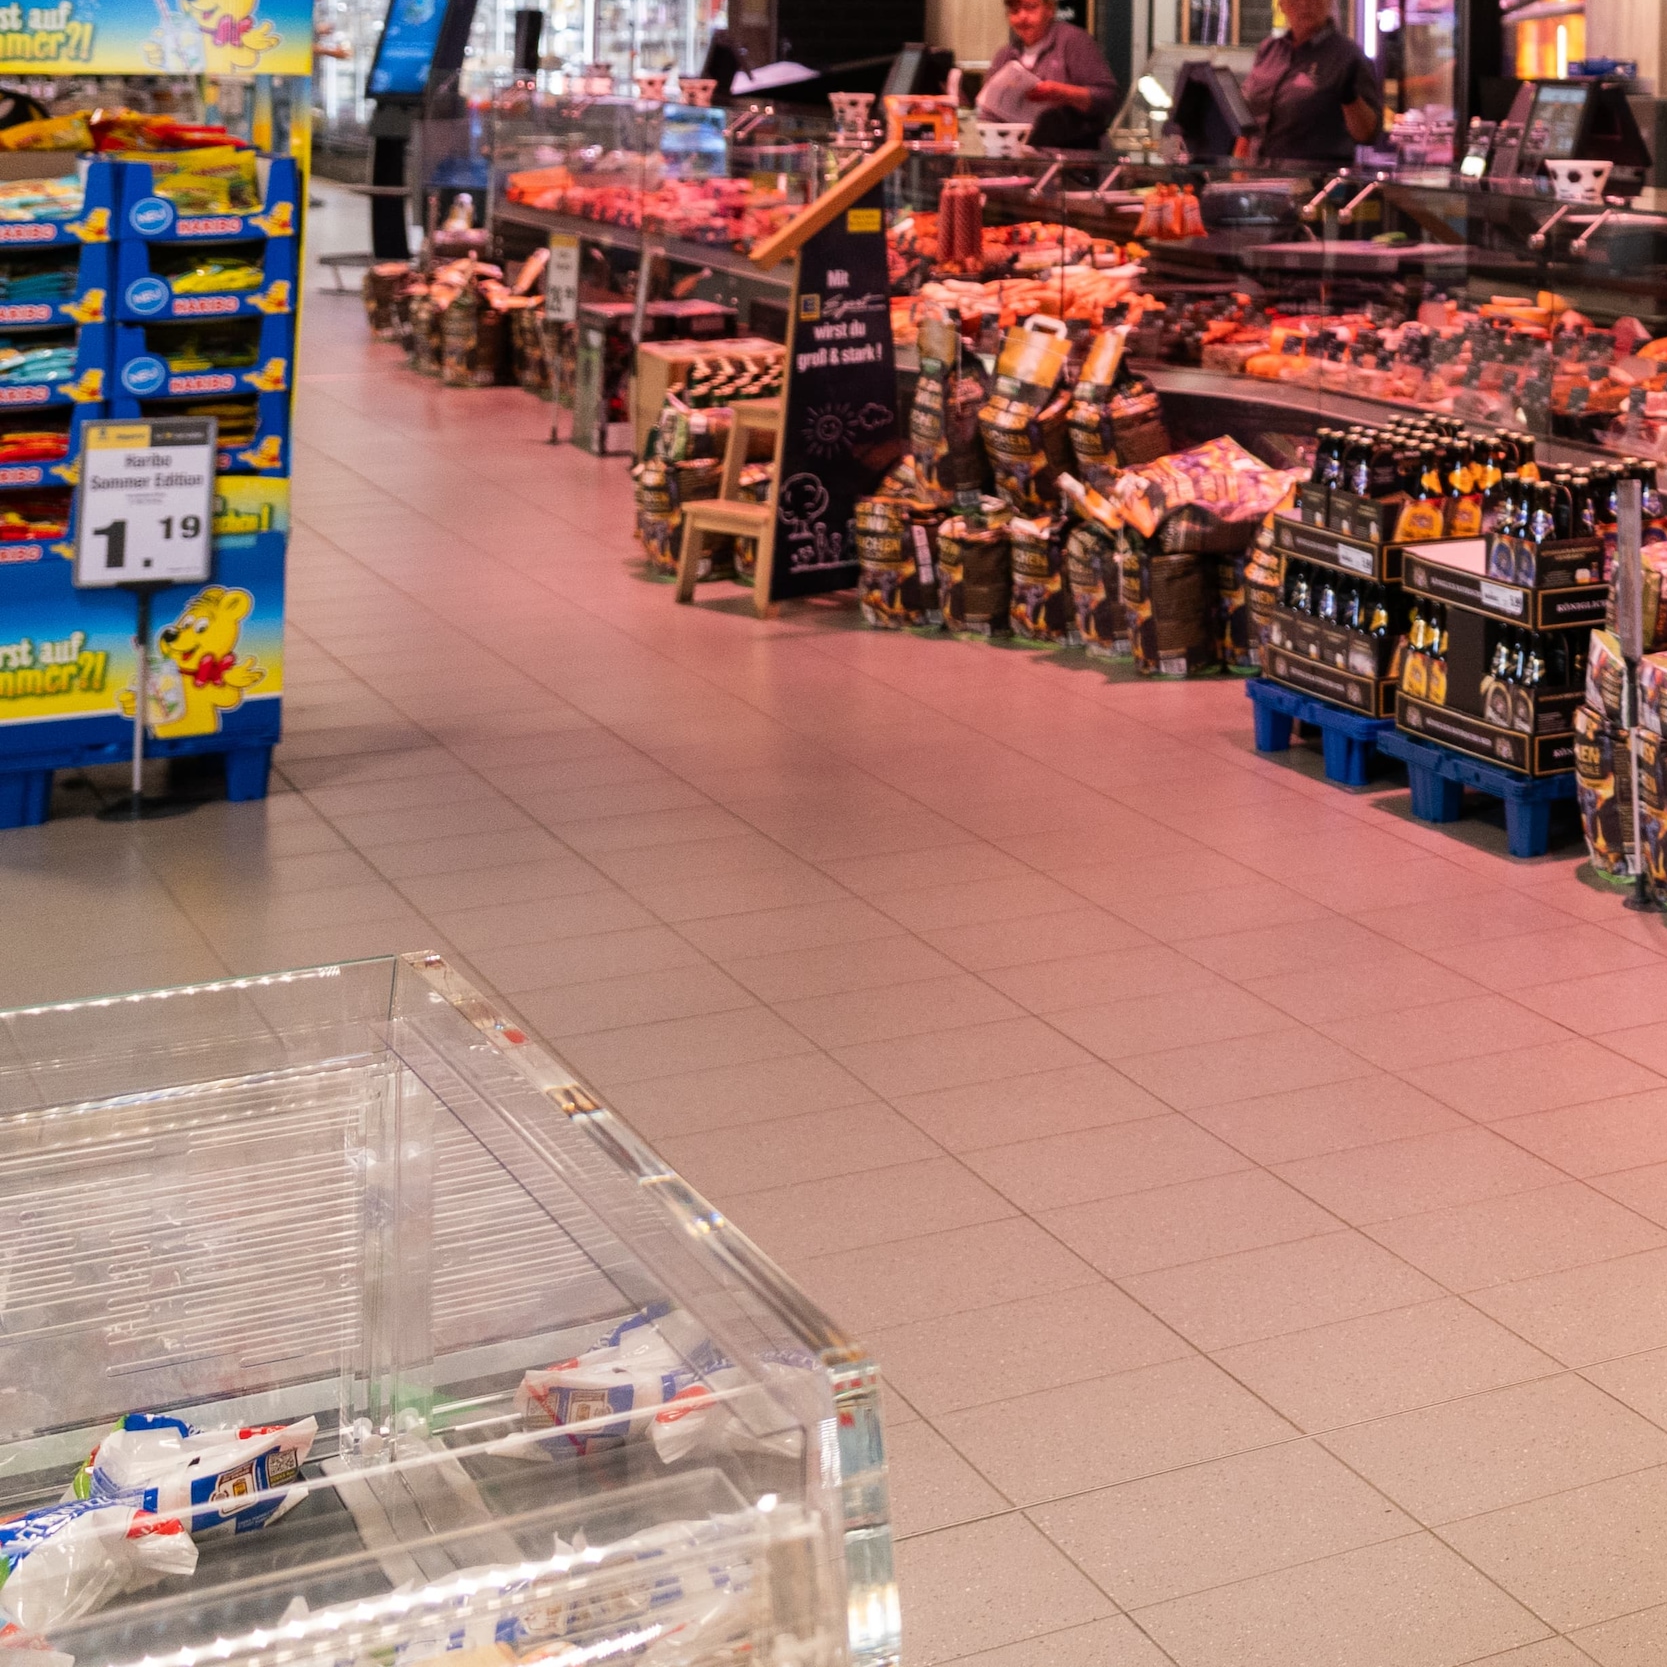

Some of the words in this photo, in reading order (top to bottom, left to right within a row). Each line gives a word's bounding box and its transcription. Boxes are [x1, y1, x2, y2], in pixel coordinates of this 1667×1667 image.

[28, 1, 72, 30] auf
[826, 270, 850, 288] Mit
[813, 323, 847, 340] wirst
[849, 319, 867, 338] du
[796, 347, 828, 372] groß
[829, 346, 840, 364] &
[841, 343, 874, 362] stark
[124, 453, 172, 468] Haribo
[90, 475, 151, 491] Sommer
[154, 473, 204, 487] Edition
[40, 631, 84, 663] auf
